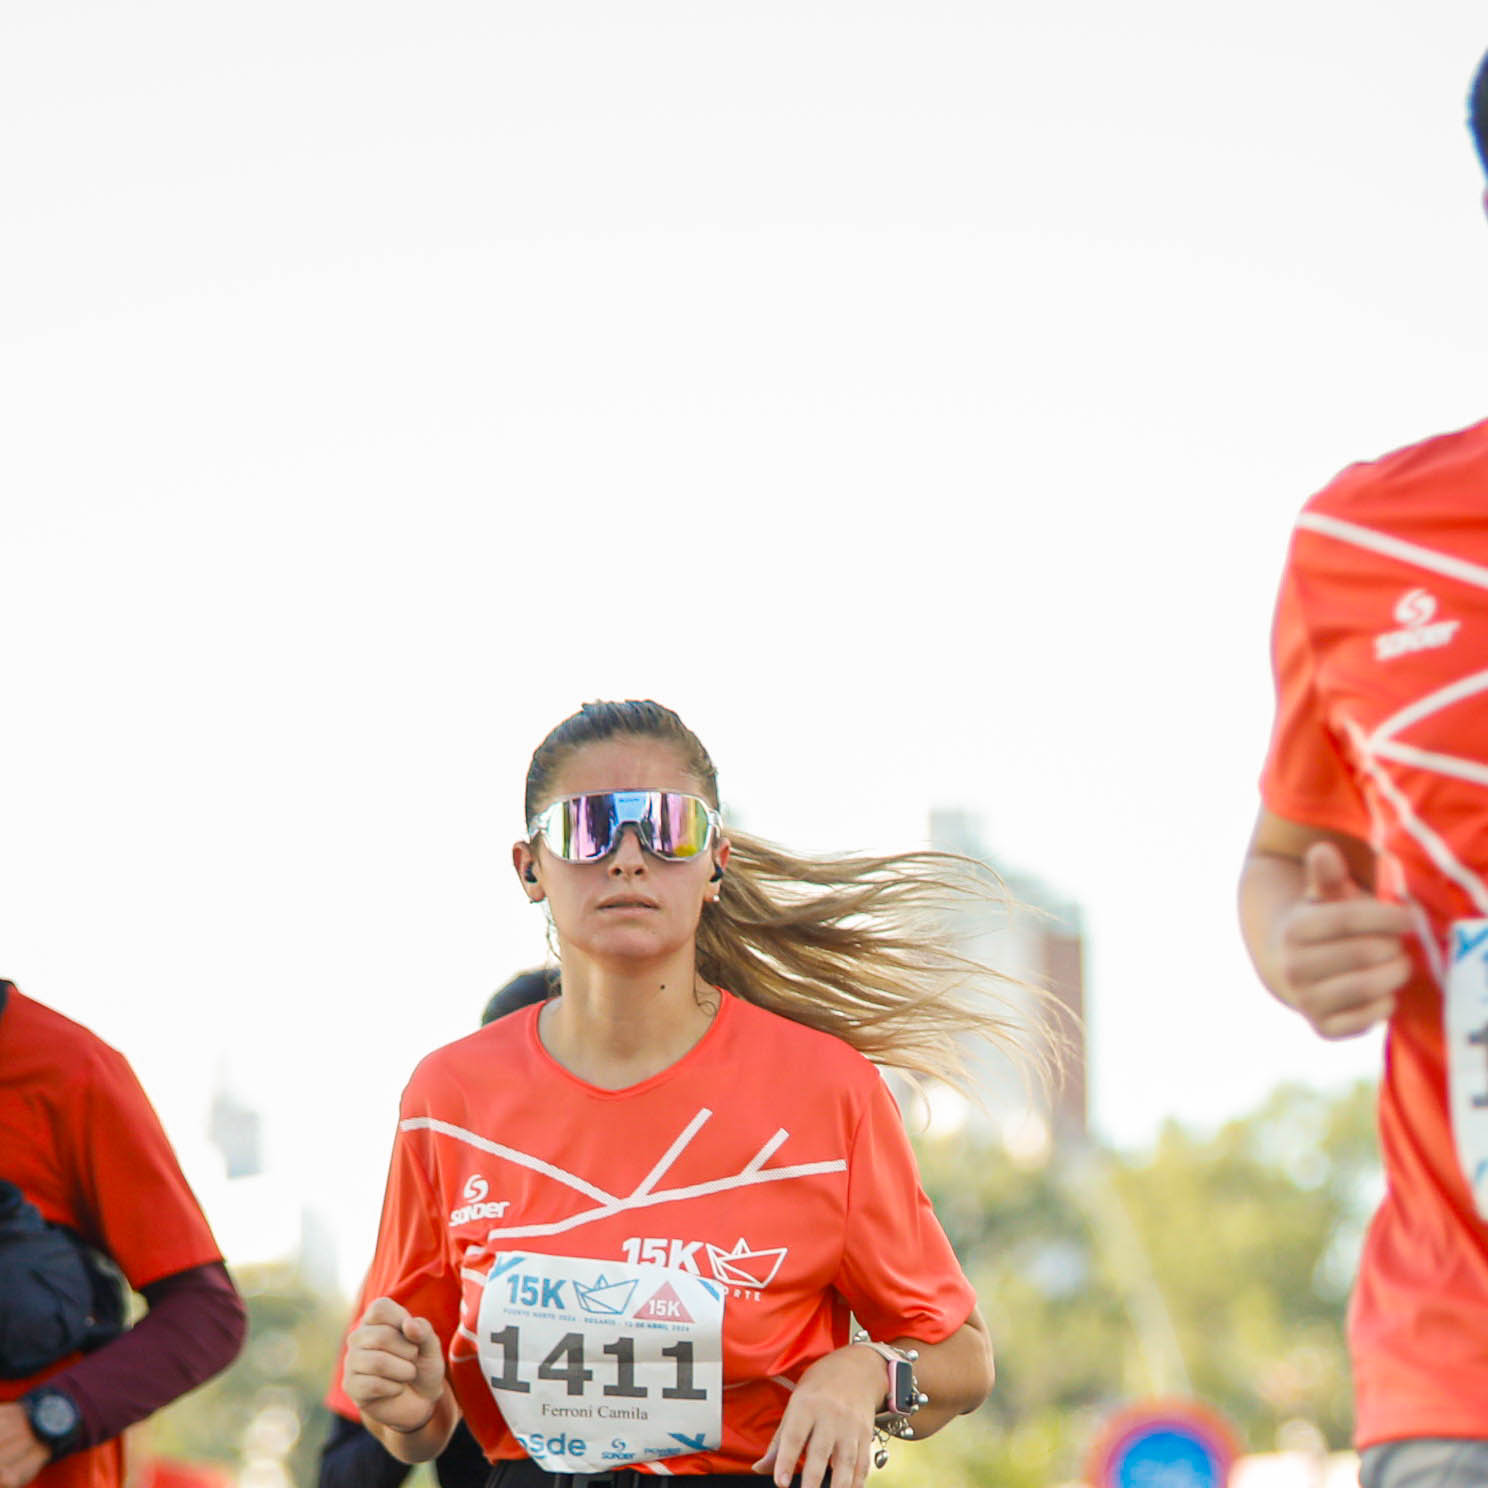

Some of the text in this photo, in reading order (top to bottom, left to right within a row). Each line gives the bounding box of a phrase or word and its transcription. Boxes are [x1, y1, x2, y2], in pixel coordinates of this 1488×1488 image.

[622, 1237, 705, 1276] 15K
[507, 1274, 566, 1309] 15K
[648, 1299, 681, 1317] 15K
[491, 1325, 707, 1400] 1411
[541, 1404, 649, 1420] Ferroni Camila
